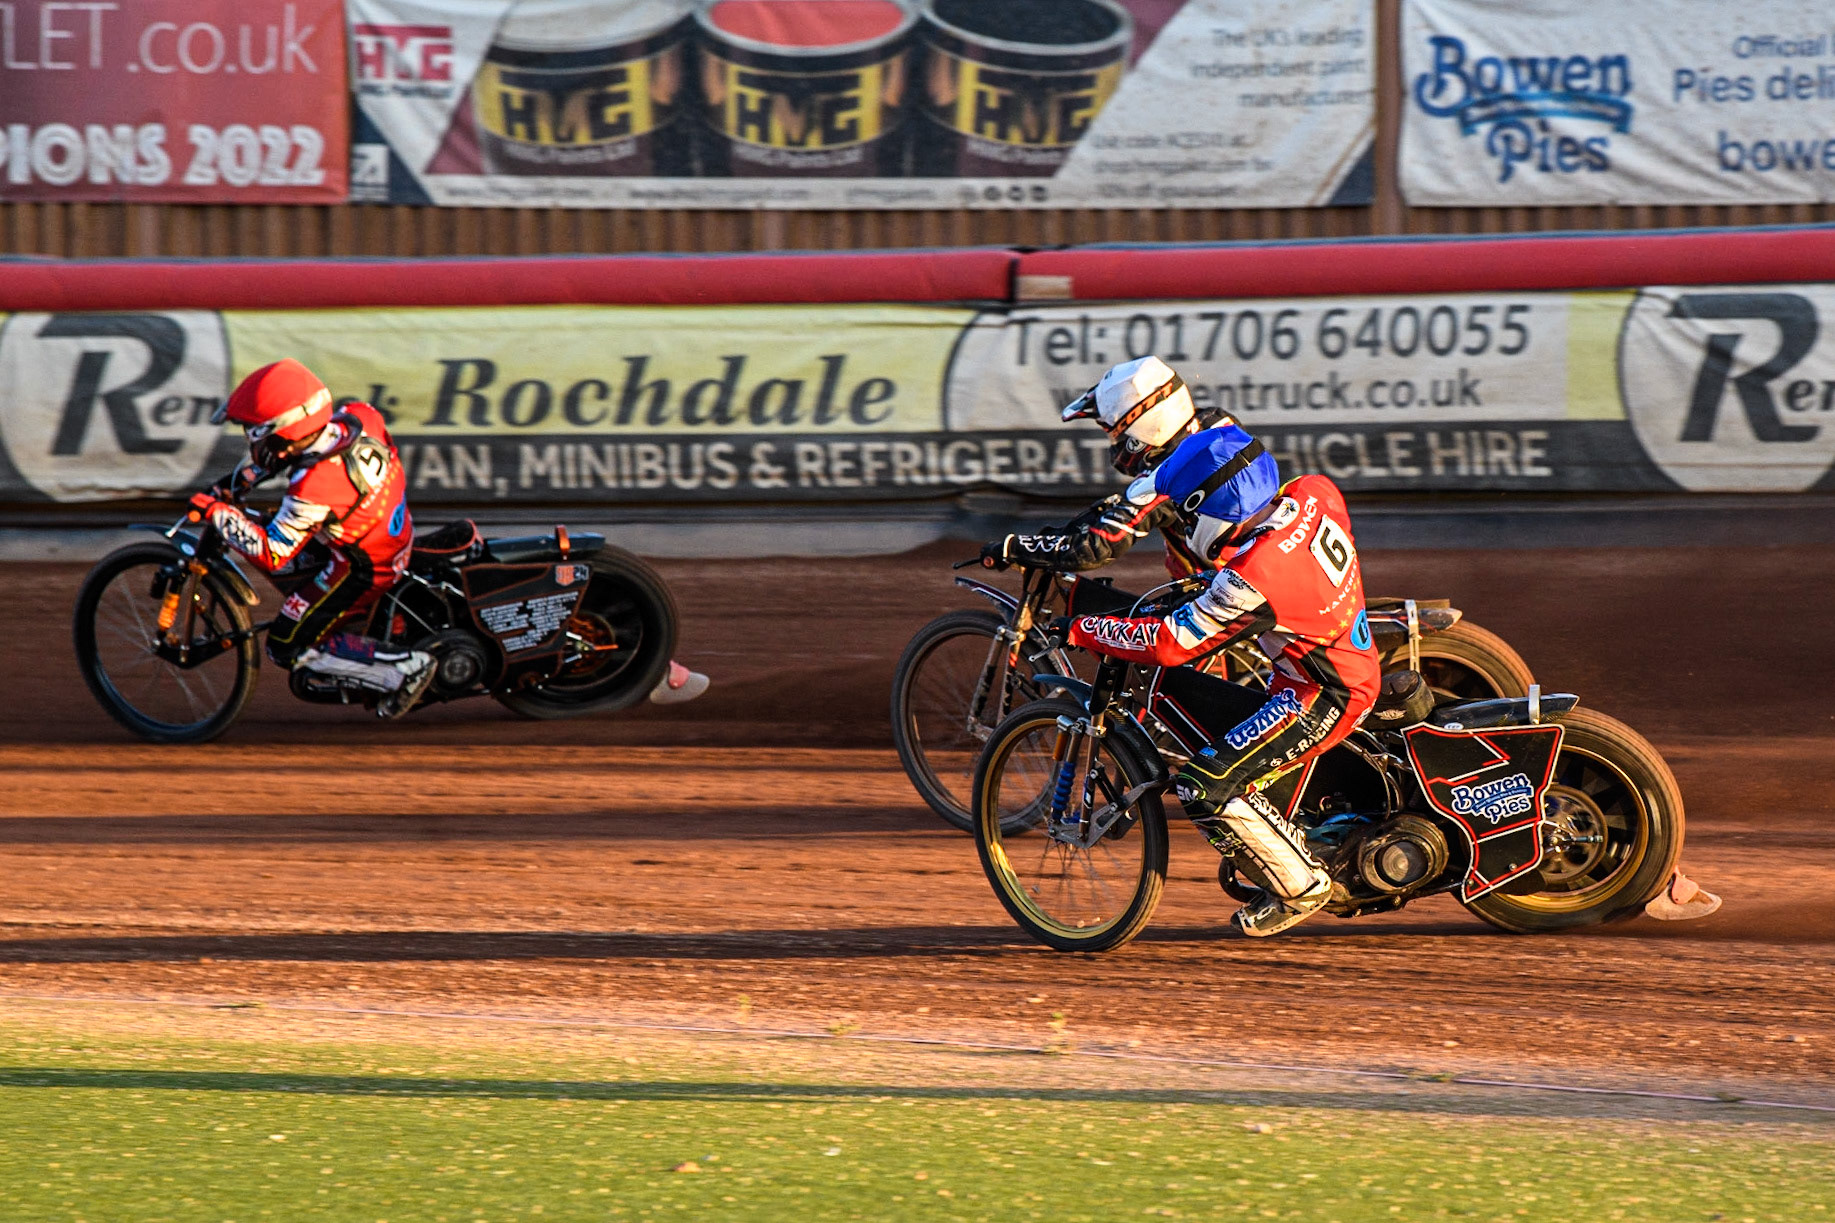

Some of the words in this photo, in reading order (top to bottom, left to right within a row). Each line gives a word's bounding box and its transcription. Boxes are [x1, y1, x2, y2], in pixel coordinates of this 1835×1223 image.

[0, 2, 318, 74] LET.co.uk
[354, 24, 453, 80] HMG
[1733, 33, 1827, 59] Official
[1414, 35, 1633, 117] Bowen
[1674, 66, 1755, 102] Pies
[501, 70, 633, 147] HMG
[736, 70, 862, 148] HMG
[976, 67, 1098, 146] HMG
[0, 123, 173, 187] IONS
[184, 124, 326, 187] 2022
[1486, 119, 1611, 184] Pies
[1013, 312, 1104, 364] Tel:
[1124, 308, 1302, 361] 01706
[1318, 304, 1532, 358] 640055
[422, 354, 898, 428] Rochdale
[1109, 382, 1174, 440] SCOTT
[519, 442, 739, 490] MINIBUS
[750, 442, 790, 488] &
[1429, 431, 1554, 477] HIRE
[1278, 495, 1318, 555] BOWEN
[1320, 526, 1348, 573] 6
[1452, 773, 1530, 814] Bowen
[1484, 797, 1531, 822] Pies
